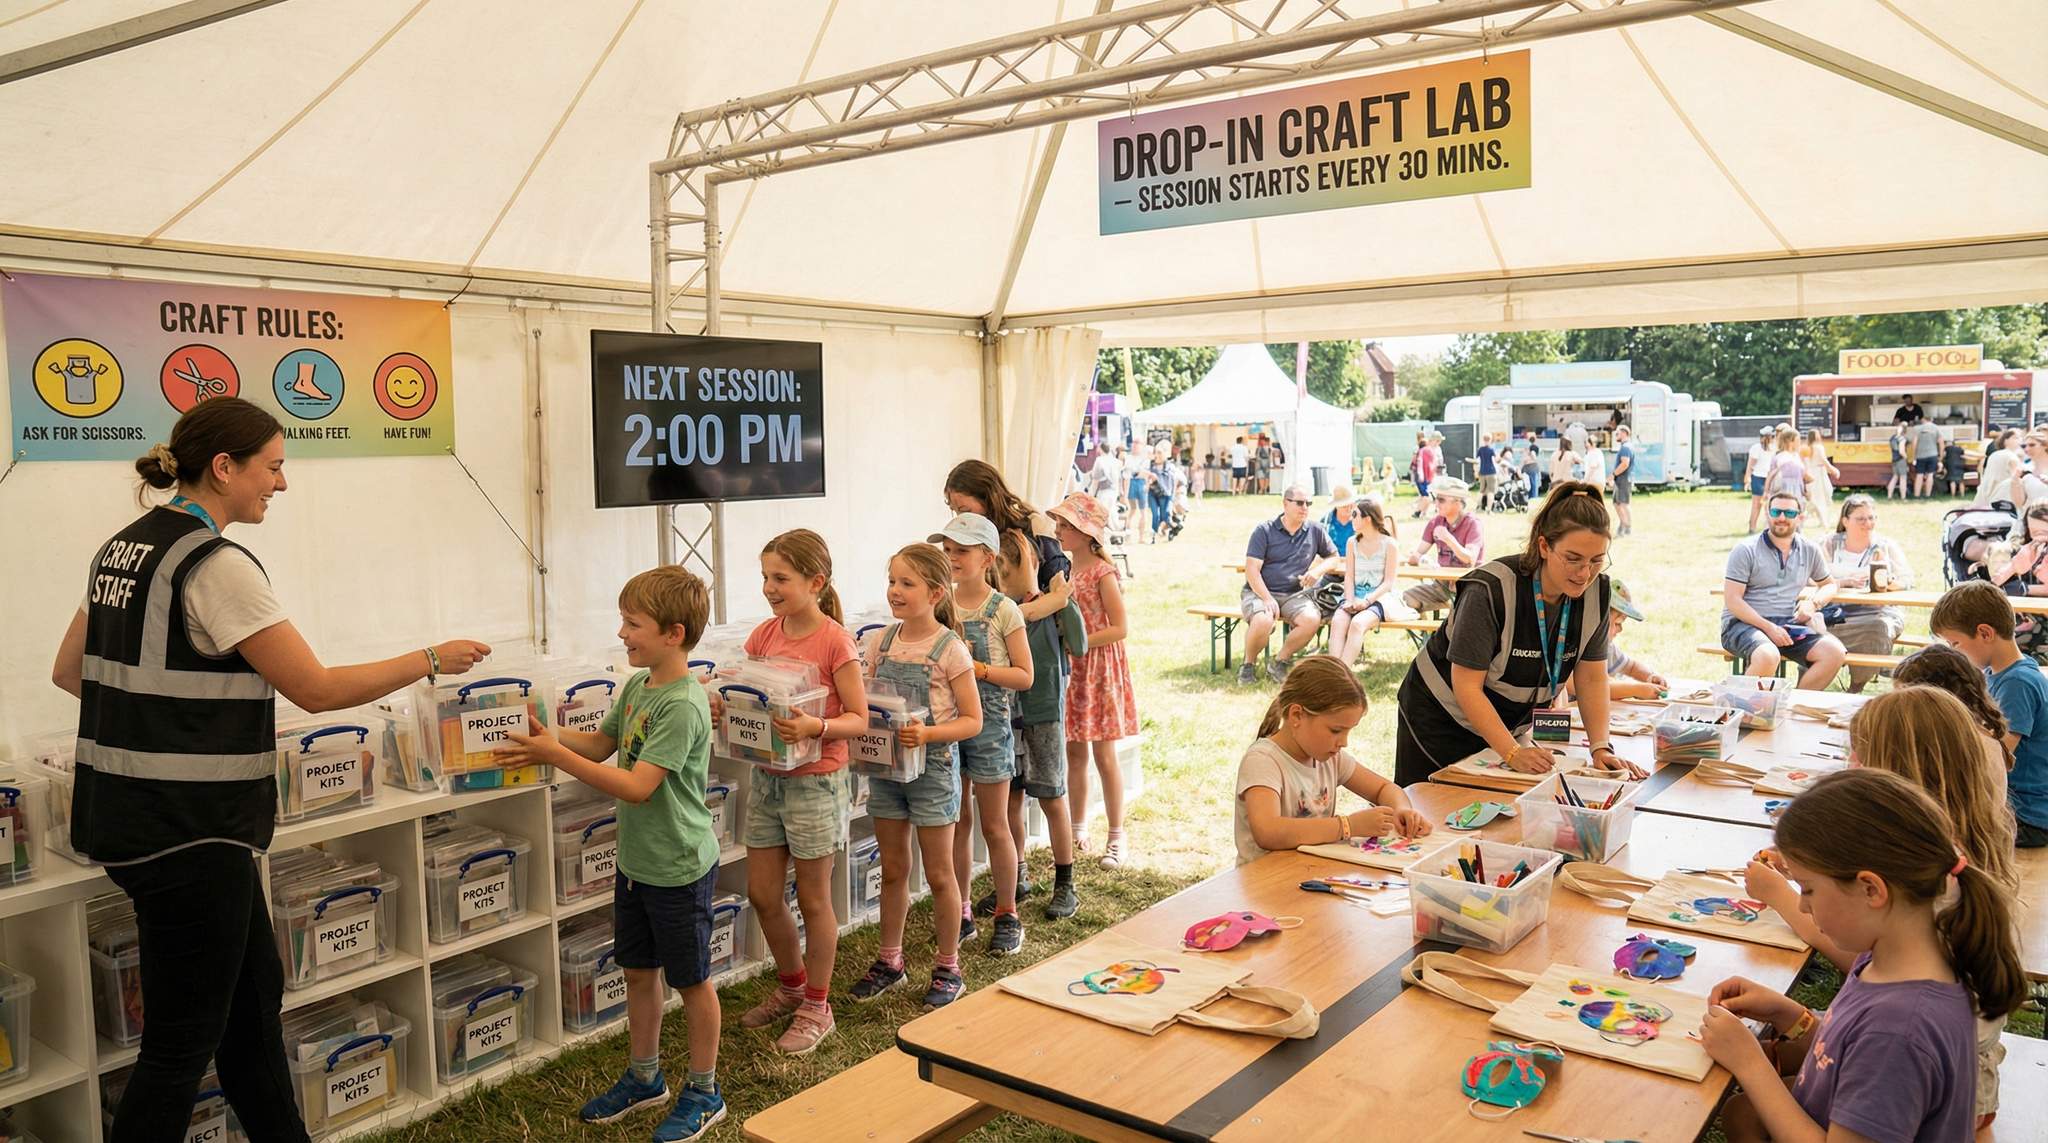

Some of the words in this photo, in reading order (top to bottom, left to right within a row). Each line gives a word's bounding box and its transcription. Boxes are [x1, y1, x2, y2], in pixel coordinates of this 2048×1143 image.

[1113, 115, 1264, 182] DROP-IN
[1278, 91, 1410, 158] CRAFT
[1427, 77, 1511, 138] LAB
[1139, 177, 1221, 212] SESSION
[1229, 165, 1310, 201] STARTS
[1318, 153, 1391, 190] EVERY
[1399, 149, 1428, 181] 30
[1437, 139, 1510, 176] MINS.
[160, 300, 247, 336] CRAFT
[257, 307, 344, 341] RULES:
[1847, 353, 1905, 369] FOOD
[624, 365, 690, 401] NEXT
[698, 367, 801, 402] SESSION:
[23, 426, 49, 440] ASK
[53, 426, 78, 440] FOR
[82, 426, 146, 440] SCISSORS.
[326, 427, 351, 439] FEET.
[384, 427, 407, 439] HAVE
[410, 427, 431, 439] FUN!
[624, 414, 725, 466] 2:00
[740, 414, 803, 465] PM
[101, 540, 155, 572] CRAFT
[92, 574, 136, 609] STAFF
[468, 714, 522, 730] PROJECT
[568, 710, 605, 726] PROJECT
[730, 716, 766, 731] PROJECT
[483, 730, 509, 742] KITS
[740, 729, 758, 742] KITS
[861, 745, 879, 756] KITS
[307, 760, 356, 778] PROJECT
[320, 776, 345, 789] KITS
[585, 848, 617, 864] PROJEC
[595, 860, 613, 872] KITS
[463, 881, 505, 901] PROJECT
[474, 896, 495, 909] KITS
[320, 920, 370, 943] PROJECT
[333, 936, 357, 952] KITS
[607, 987, 626, 999] KITS
[469, 1016, 513, 1040] PROJECT
[480, 1031, 502, 1047] KITS
[331, 1066, 381, 1094] PROJECT
[345, 1084, 370, 1102] KITS
